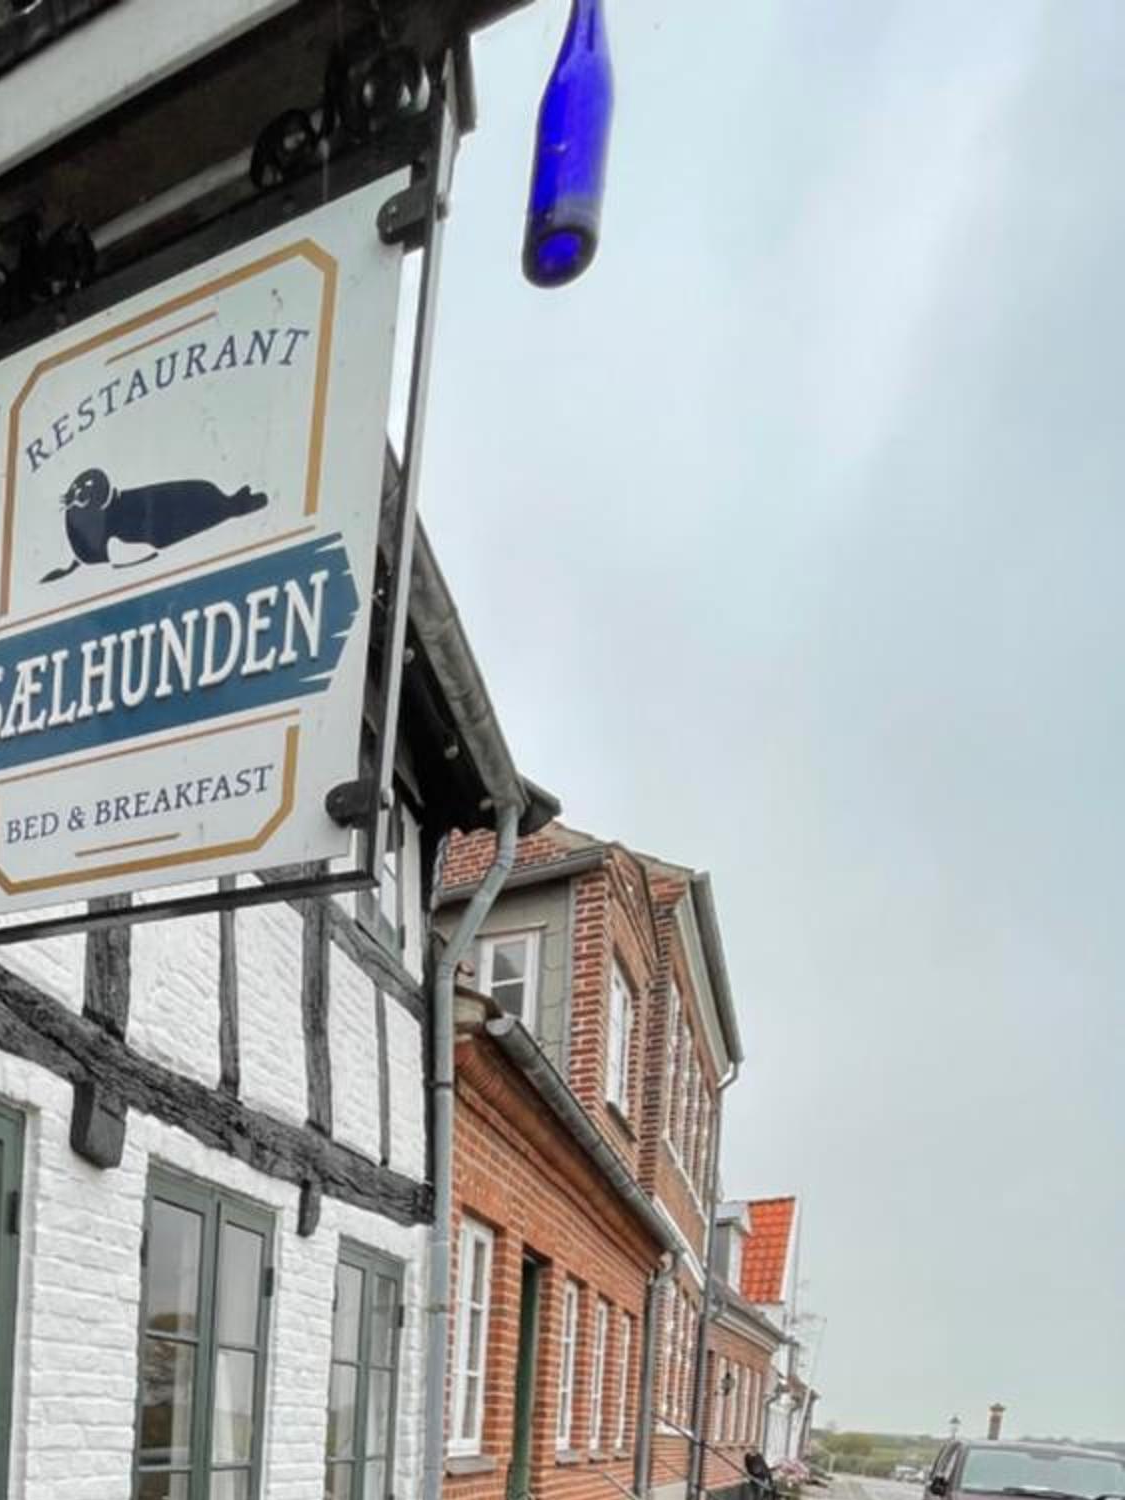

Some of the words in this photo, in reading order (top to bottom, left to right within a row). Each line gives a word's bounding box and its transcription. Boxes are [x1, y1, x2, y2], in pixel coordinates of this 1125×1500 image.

[25, 327, 310, 473] RESTAURANT
[6, 811, 59, 844] BED
[67, 807, 87, 831] &
[94, 765, 274, 826] BREAKFAST
